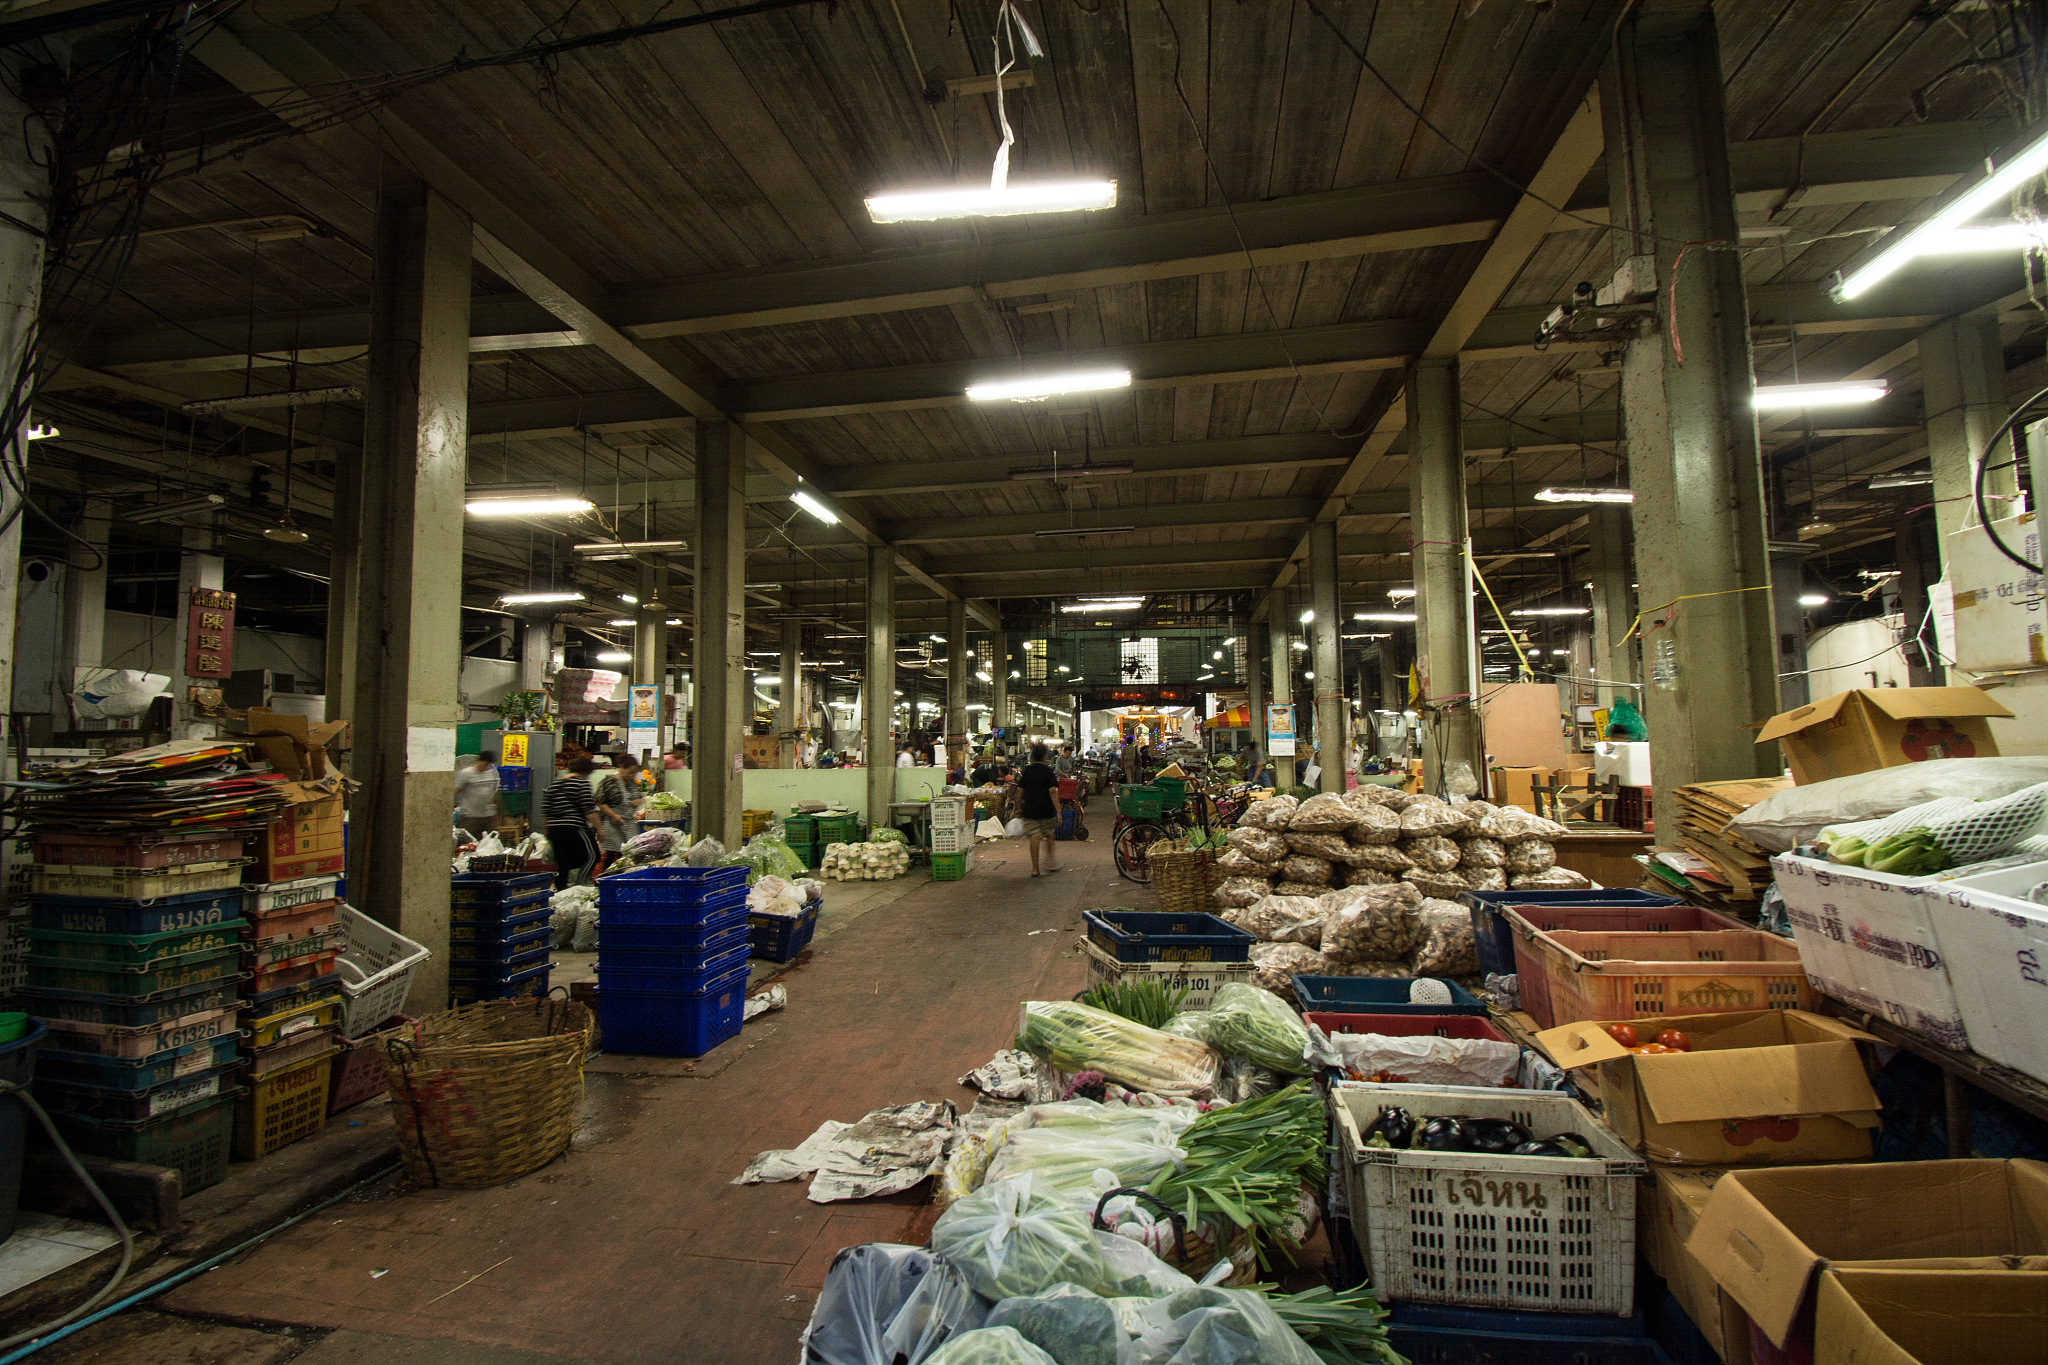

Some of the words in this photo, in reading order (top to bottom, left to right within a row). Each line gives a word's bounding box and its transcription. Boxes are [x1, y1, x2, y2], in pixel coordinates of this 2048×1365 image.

[302, 823, 310, 832] A
[302, 839, 310, 848] B
[161, 899, 222, 932] แบงค์
[1191, 978, 1210, 991] 101
